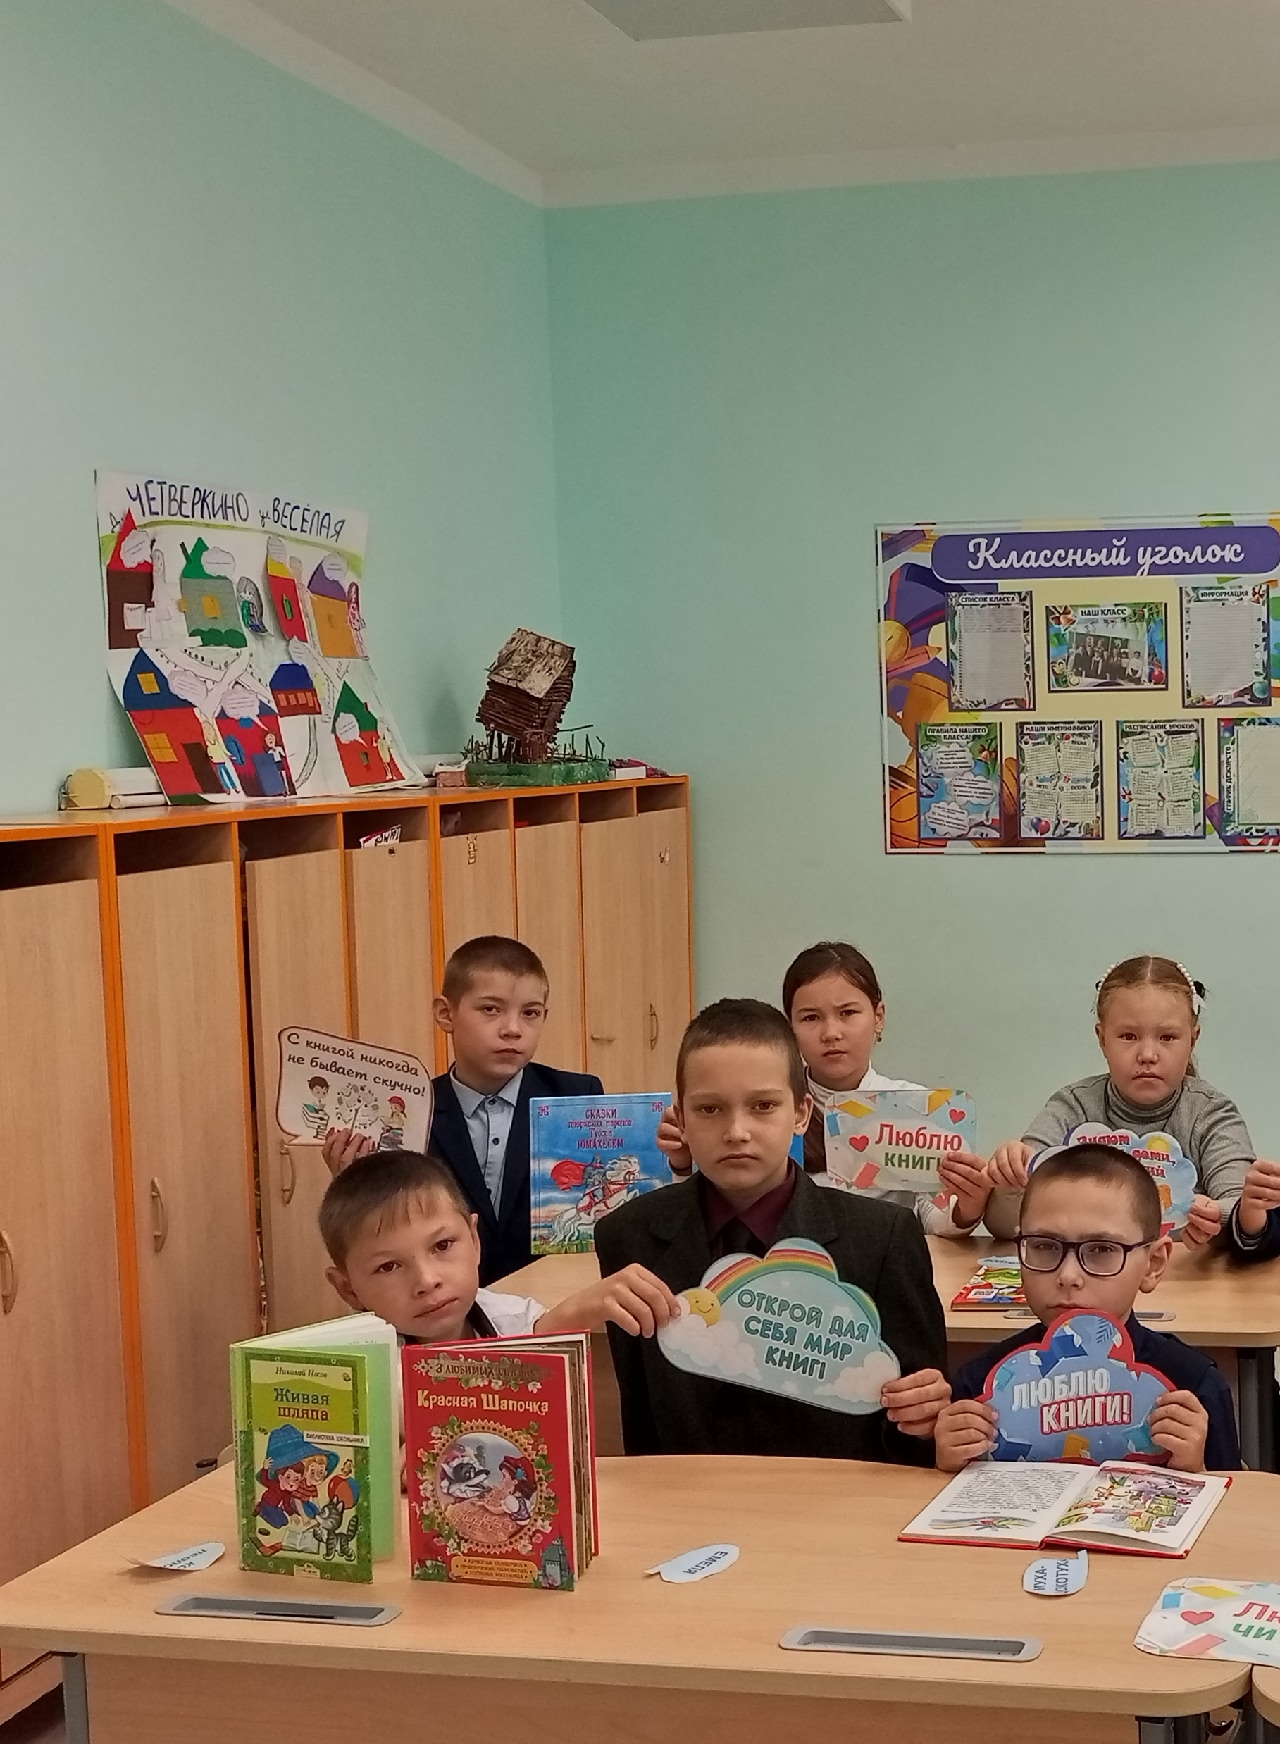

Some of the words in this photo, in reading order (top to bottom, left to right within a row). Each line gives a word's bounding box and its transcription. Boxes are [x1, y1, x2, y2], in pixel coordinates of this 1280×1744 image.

[126, 479, 249, 522] ЧЕТВЕРКИНО
[967, 537, 1131, 570] Классный
[1136, 543, 1244, 576] уголок
[1200, 590, 1249, 598] ИНФОРМАЦИЯ
[1080, 609, 1098, 617] НАШ
[1099, 608, 1127, 616] КЛАСС
[287, 1032, 300, 1045] С
[305, 1039, 355, 1060] книгой
[360, 1053, 419, 1077] никогда
[287, 1053, 305, 1065] не
[310, 1057, 368, 1081] бывает
[373, 1075, 426, 1097] скучно!
[874, 1123, 963, 1151] Люблю
[737, 1289, 823, 1329] ОТКРОЙ
[829, 1315, 870, 1343] ДЛЯ
[744, 1315, 797, 1345] СЕБЯ
[803, 1332, 853, 1362] МИР
[275, 1366, 306, 1377] Николай
[308, 1369, 328, 1378] Носов
[445, 1364, 494, 1377] ЛЮБИМЫХ
[273, 1387, 330, 1405] Живая
[417, 1389, 477, 1409] Красная
[481, 1393, 549, 1415] Шапочка
[1011, 1368, 1110, 1412] ЛЮБЛЮ
[277, 1406, 329, 1421] шляпа
[1042, 1394, 1131, 1434] КНИГИ!
[683, 1551, 728, 1574] ЕМЕЛЯ
